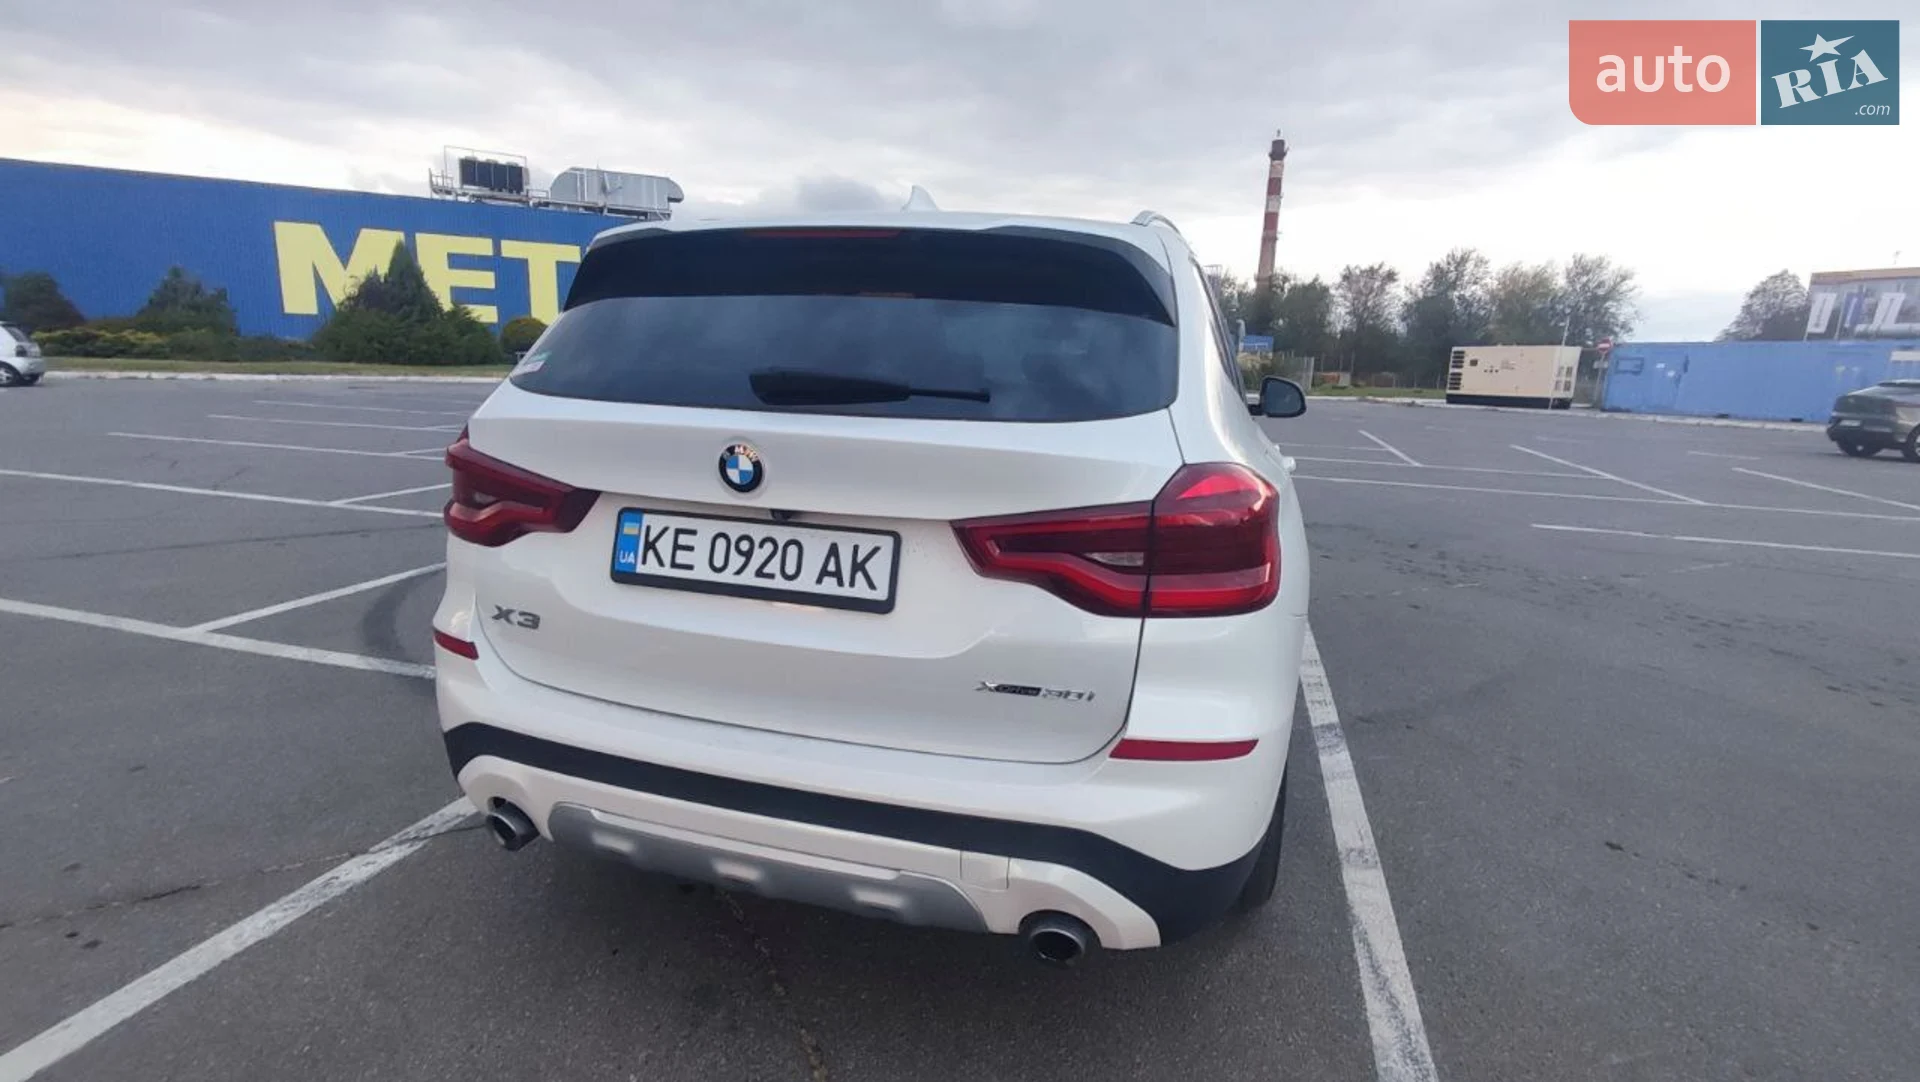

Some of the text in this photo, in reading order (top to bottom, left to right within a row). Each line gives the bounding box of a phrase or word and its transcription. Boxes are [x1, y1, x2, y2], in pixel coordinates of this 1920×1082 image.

[618, 549, 636, 564] UA
[641, 525, 882, 591] KE 0920 AK
[491, 604, 541, 630] X3
